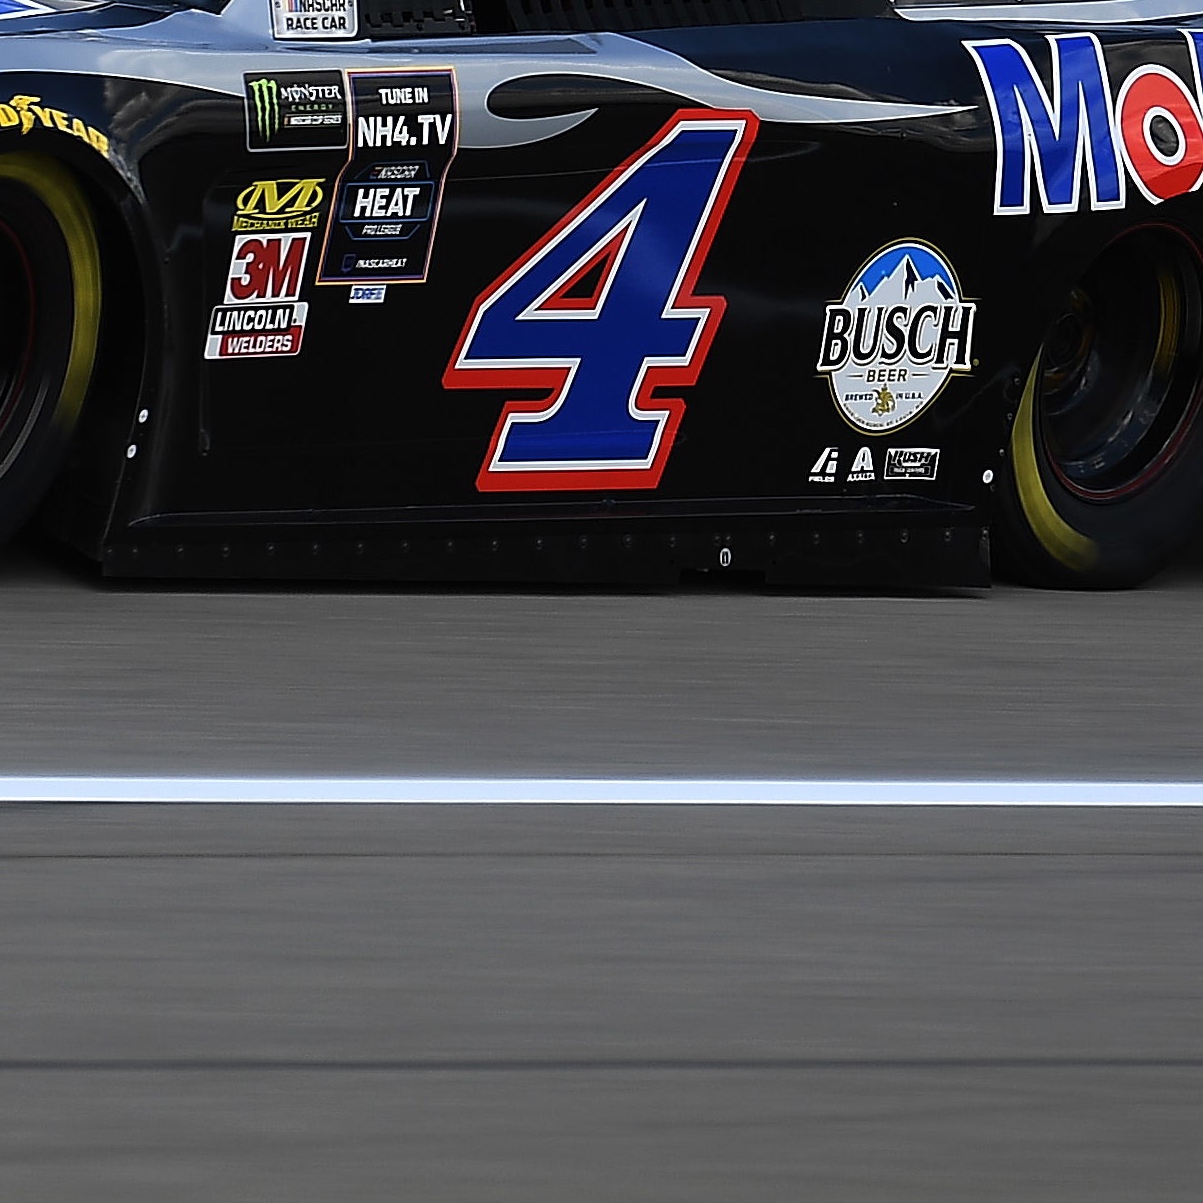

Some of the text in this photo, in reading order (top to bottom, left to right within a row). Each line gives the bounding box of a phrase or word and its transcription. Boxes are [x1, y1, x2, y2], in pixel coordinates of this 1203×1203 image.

[286, 16, 347, 30] RACE CAR
[379, 87, 429, 105] TUNE IN
[357, 113, 453, 147] NH4.TV
[961, 32, 1203, 215] Mo
[354, 187, 420, 217] HEAT
[287, 212, 319, 228] WEAR
[230, 236, 308, 301] 3M
[442, 108, 760, 492] 4
[214, 308, 290, 332] LINCOLN
[227, 334, 293, 354] WELDERS
[817, 302, 976, 372] BUSCH
[866, 368, 908, 383] BEER
